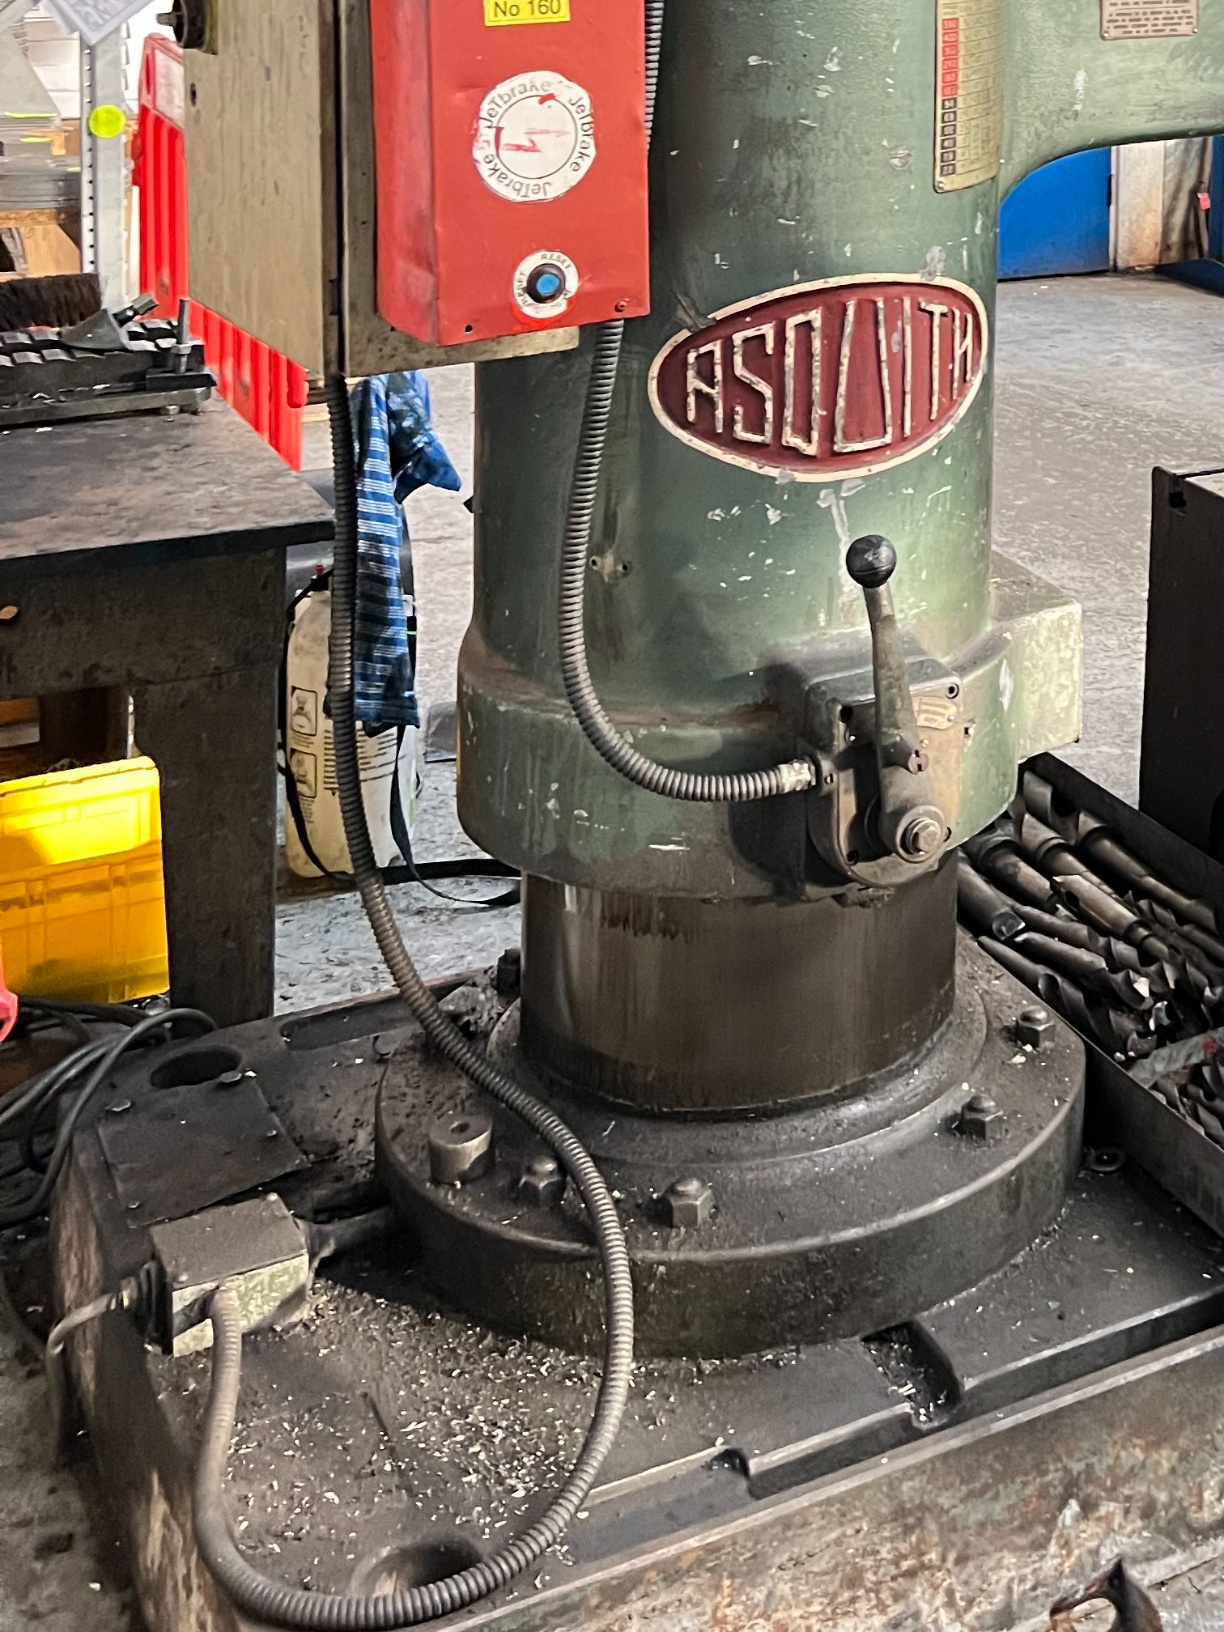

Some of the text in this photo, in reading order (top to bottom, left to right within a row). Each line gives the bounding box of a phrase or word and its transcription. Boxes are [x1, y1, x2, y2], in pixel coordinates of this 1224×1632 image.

[493, 0, 520, 18] No
[540, 253, 572, 270] RESET
[686, 296, 973, 458] ASQUITH
